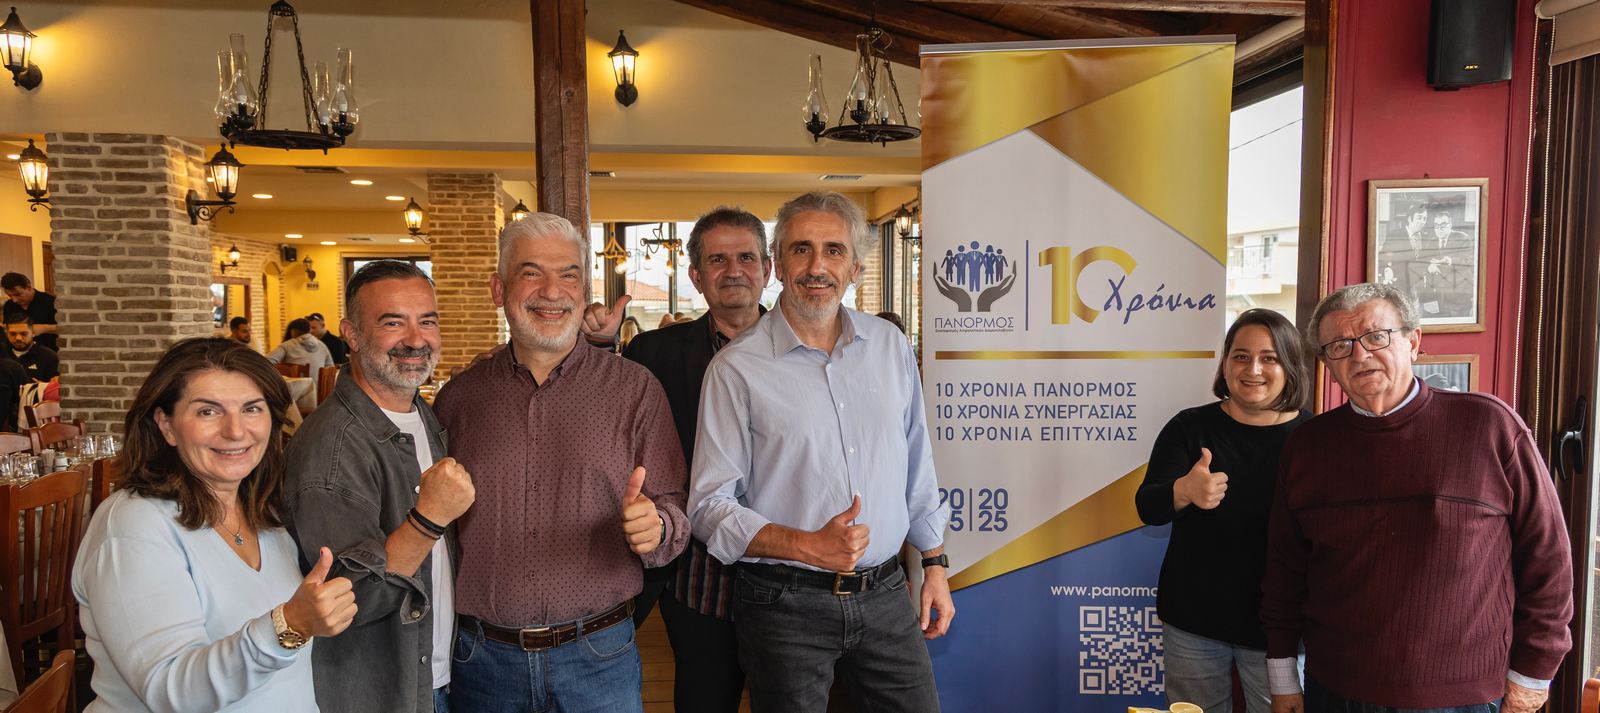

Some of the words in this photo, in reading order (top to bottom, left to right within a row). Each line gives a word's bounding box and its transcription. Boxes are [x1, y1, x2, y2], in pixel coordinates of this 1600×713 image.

[1104, 275, 1216, 325] Χρόνια
[935, 317, 1014, 328] ΠΑΝΟΡΜΟΣ
[936, 382, 954, 397] 10
[959, 382, 1027, 397] ΧΡΟΝΙΑ
[1033, 382, 1137, 397] ΠΑΝΟΡΜΟΣ
[936, 404, 953, 419] 10
[957, 404, 1020, 419] ΧΡΟΝΙΑ
[1024, 404, 1137, 419] ΣΥΝΕΡΓΑΣΙΑΣ
[936, 426, 955, 441] 10
[961, 426, 1033, 441] ΧΡΟΝΙΑ
[1040, 426, 1137, 441] ΕΠΙΤΥΧΙΑΣ
[979, 488, 1008, 510] 20
[949, 510, 964, 532] 5
[979, 510, 1008, 532] 25
